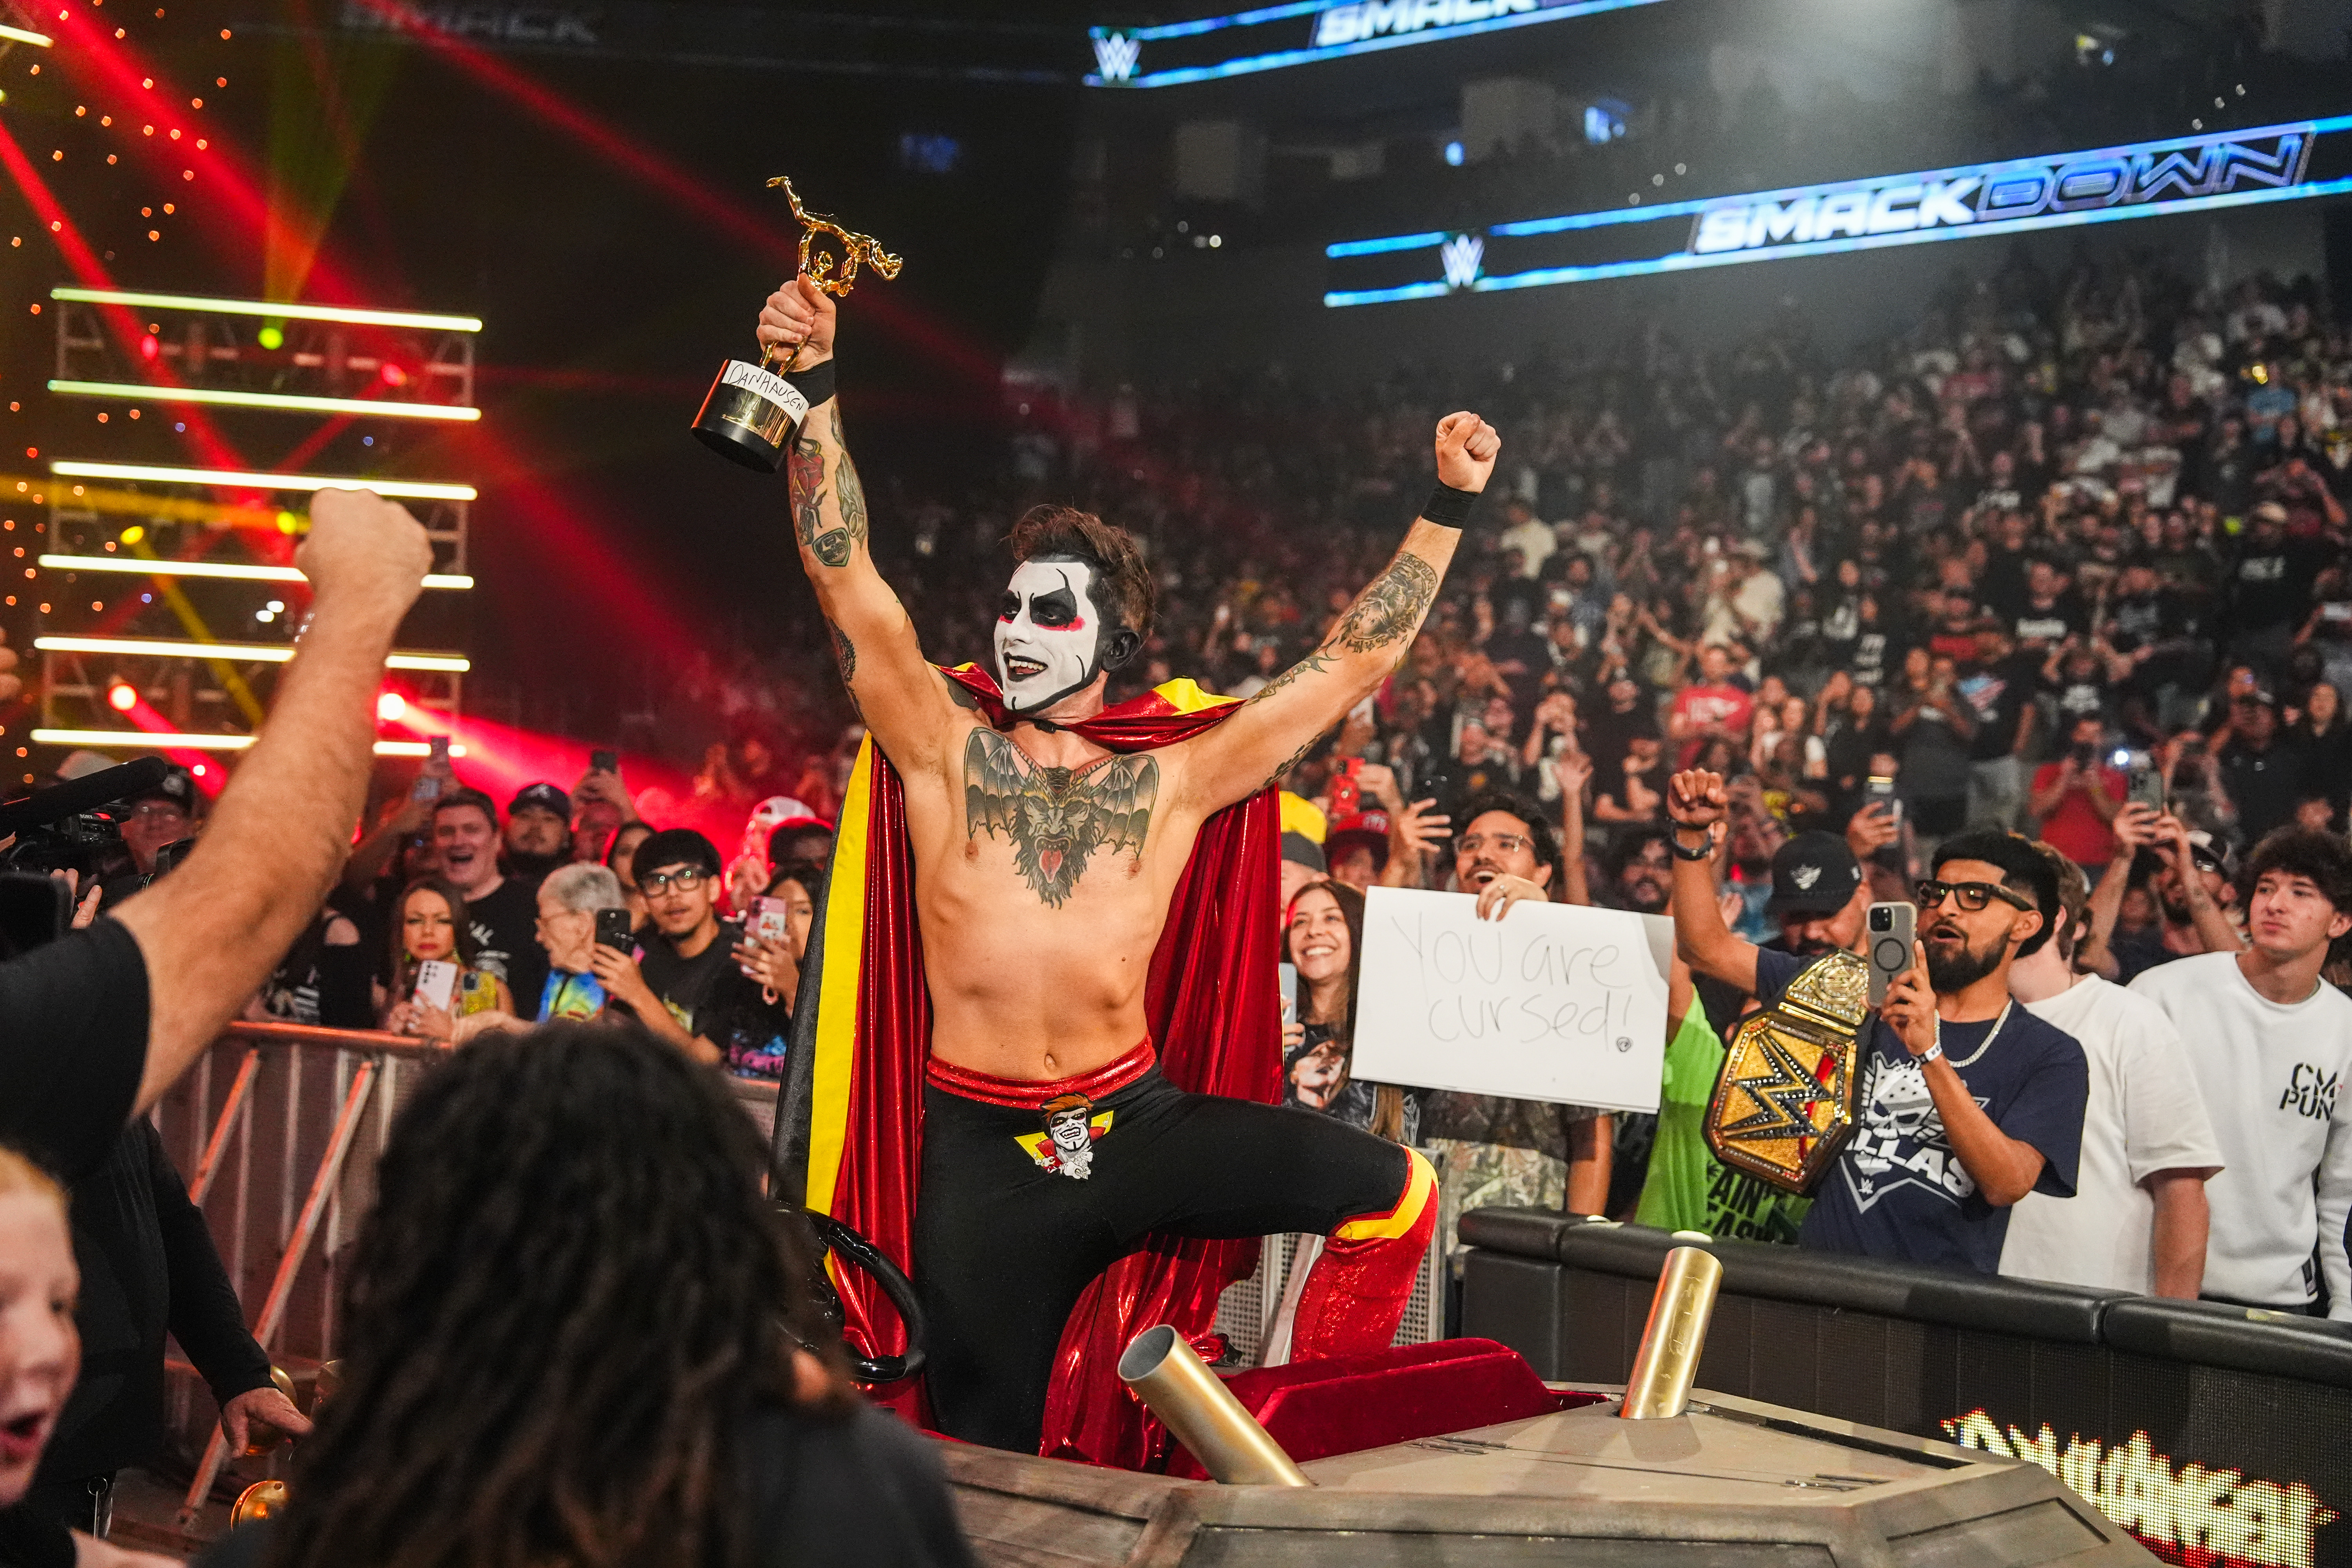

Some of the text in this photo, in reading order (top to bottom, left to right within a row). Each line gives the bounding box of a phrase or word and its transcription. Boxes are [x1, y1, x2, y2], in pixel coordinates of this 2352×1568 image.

[1695, 133, 2303, 255] SMACKDOWN
[727, 364, 805, 411] DANHAUSEN
[1521, 934, 1632, 989] are
[1428, 989, 1634, 1053] cursed!
[1845, 1127, 1975, 1198] LLAS
